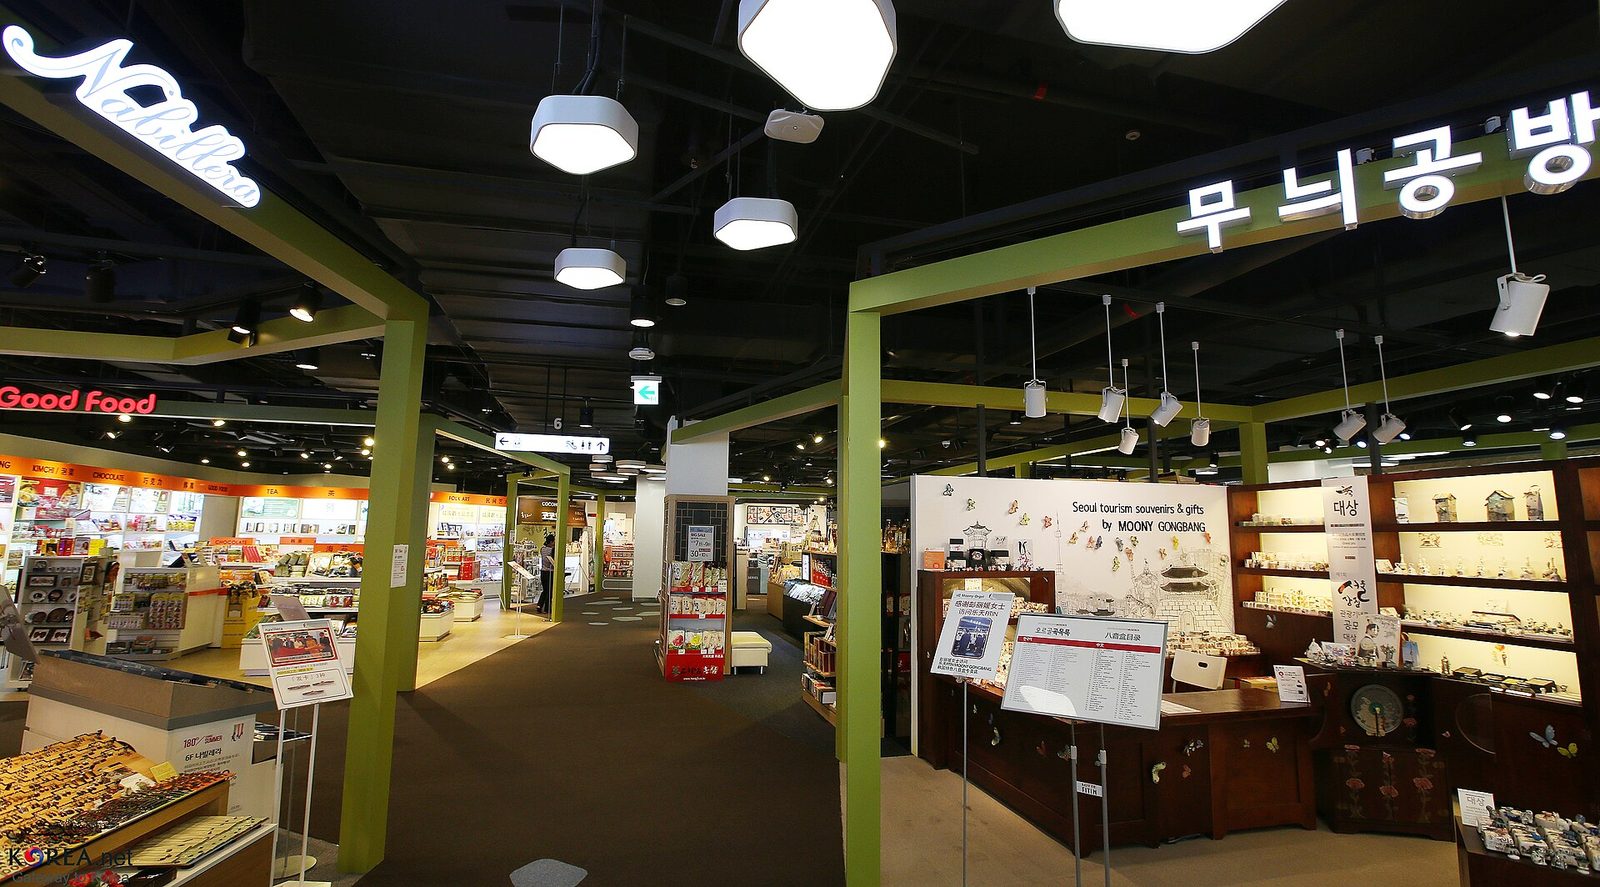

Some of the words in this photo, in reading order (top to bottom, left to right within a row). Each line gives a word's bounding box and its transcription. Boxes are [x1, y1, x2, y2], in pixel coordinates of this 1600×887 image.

[1177, 90, 1600, 254] 무늬공방
[0, 386, 79, 411] Good
[84, 390, 156, 414] Food
[553, 418, 563, 430] 6
[32, 464, 54, 474] KIMCHI
[92, 471, 125, 482] CHOCOLATE
[1072, 501, 1097, 513] Seoul
[1100, 503, 1133, 514] tourism
[1135, 504, 1175, 514] souvenirs
[1177, 503, 1184, 514] &
[1186, 504, 1204, 516] gifts
[1333, 499, 1359, 516] 대상
[1102, 519, 1112, 532] by
[1118, 520, 1153, 532] MOONY
[1158, 521, 1206, 533] GONGBANG
[1104, 631, 1141, 642] 八音盒目录
[185, 753, 194, 761] 6F
